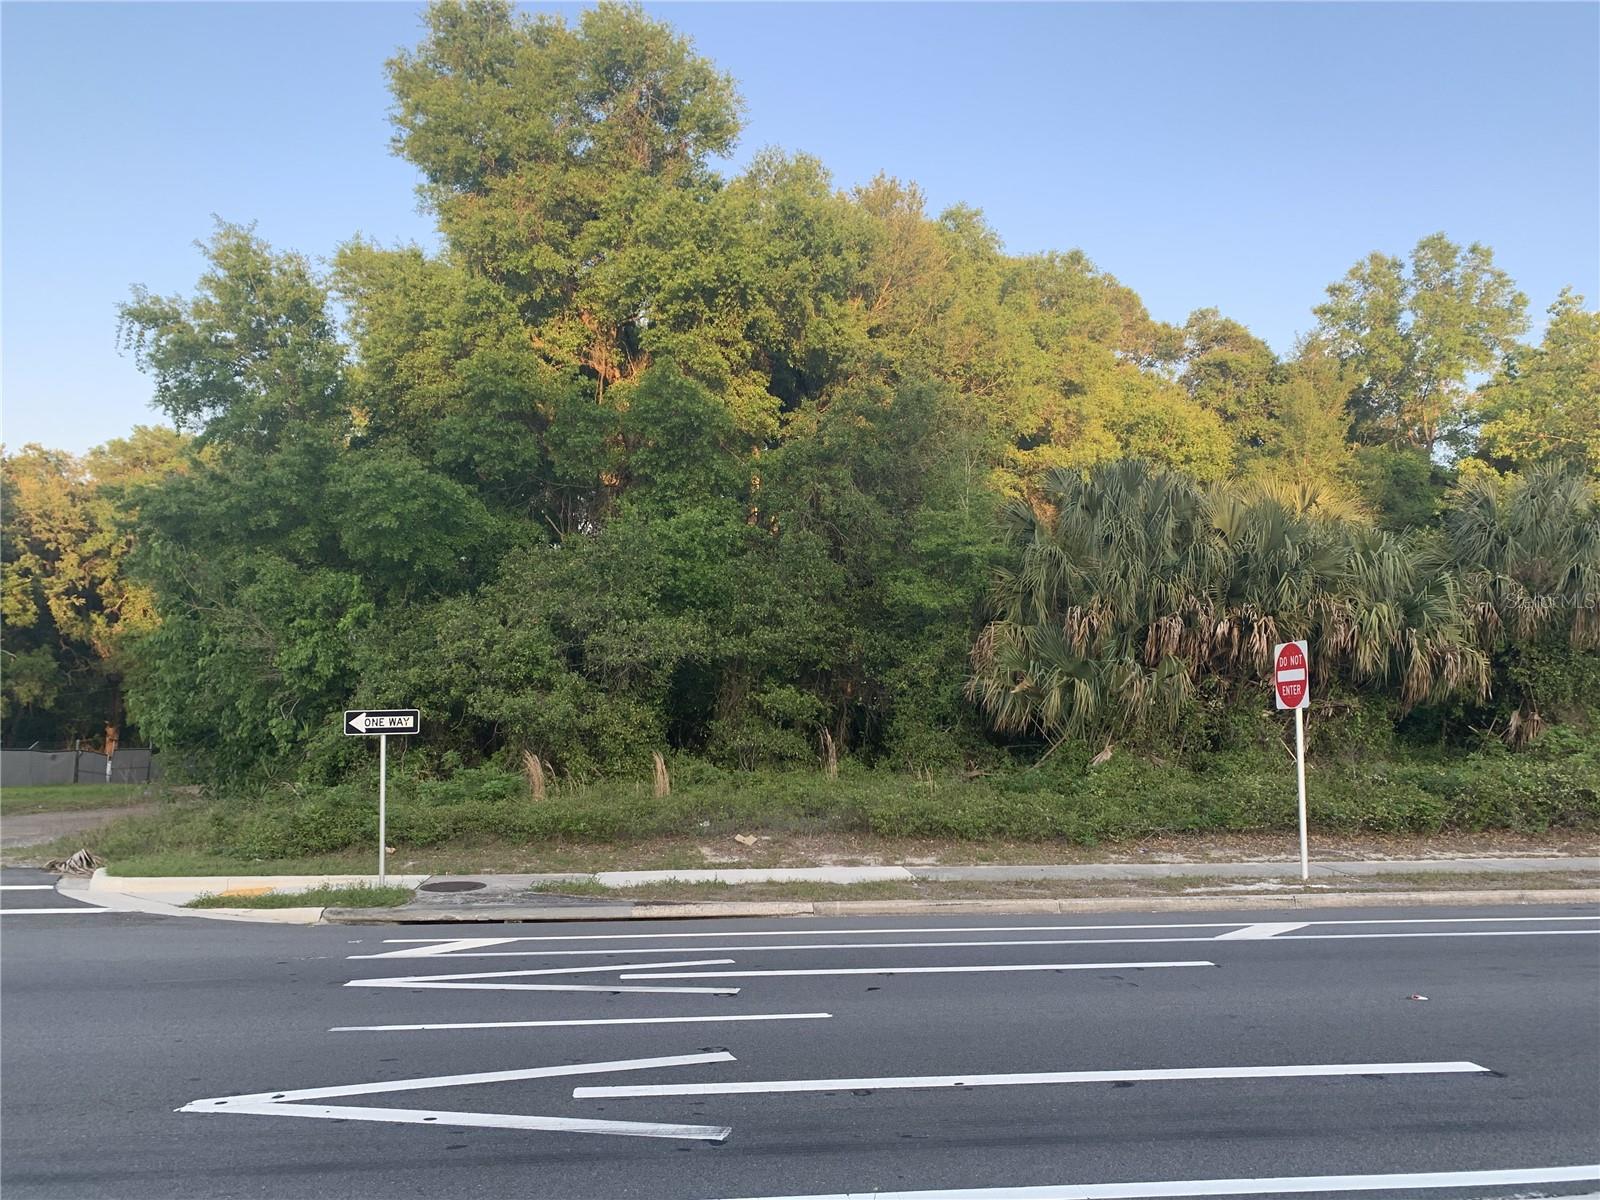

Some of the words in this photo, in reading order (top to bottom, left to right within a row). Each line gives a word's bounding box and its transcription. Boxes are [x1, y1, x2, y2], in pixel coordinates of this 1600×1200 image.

[1279, 657, 1287, 667] DO
[1290, 655, 1302, 666] NOT
[1282, 685, 1302, 696] ENTER
[364, 718, 385, 727] ONE
[388, 717, 410, 727] WAY
